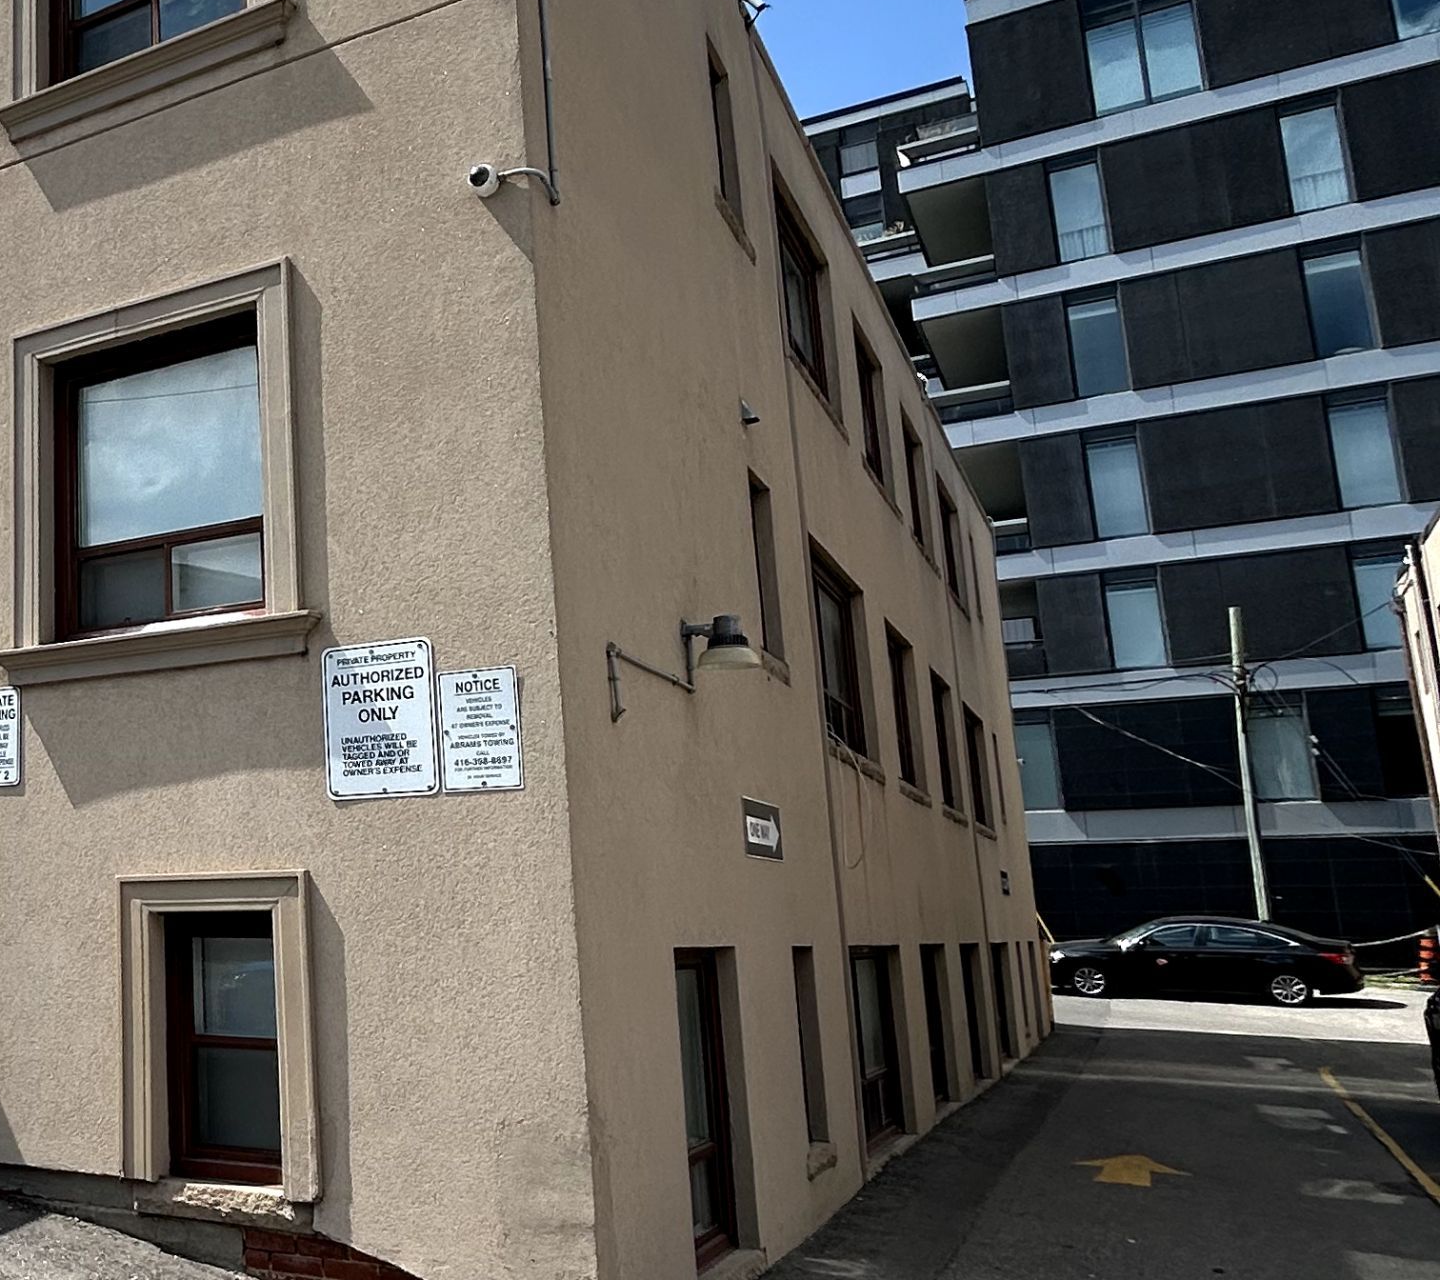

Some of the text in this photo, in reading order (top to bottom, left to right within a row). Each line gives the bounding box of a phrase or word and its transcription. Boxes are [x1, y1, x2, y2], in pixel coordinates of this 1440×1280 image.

[337, 651, 416, 666] PRIVATE PROPERTY
[331, 666, 424, 688] AUTHORIZED
[455, 678, 501, 693] NOTICE
[342, 685, 414, 705] PARKING
[358, 705, 399, 723] ONLY
[341, 733, 407, 745] UNAUTHORIZED
[450, 737, 515, 749] ABRAMS TOWING
[342, 740, 417, 753] VEHICLES WILL BE
[342, 751, 375, 760] TAGGED
[343, 757, 409, 768] TOWED AWAY AT
[3, 770, 10, 780] 2
[343, 764, 423, 777] OWNER'S EXPENSE
